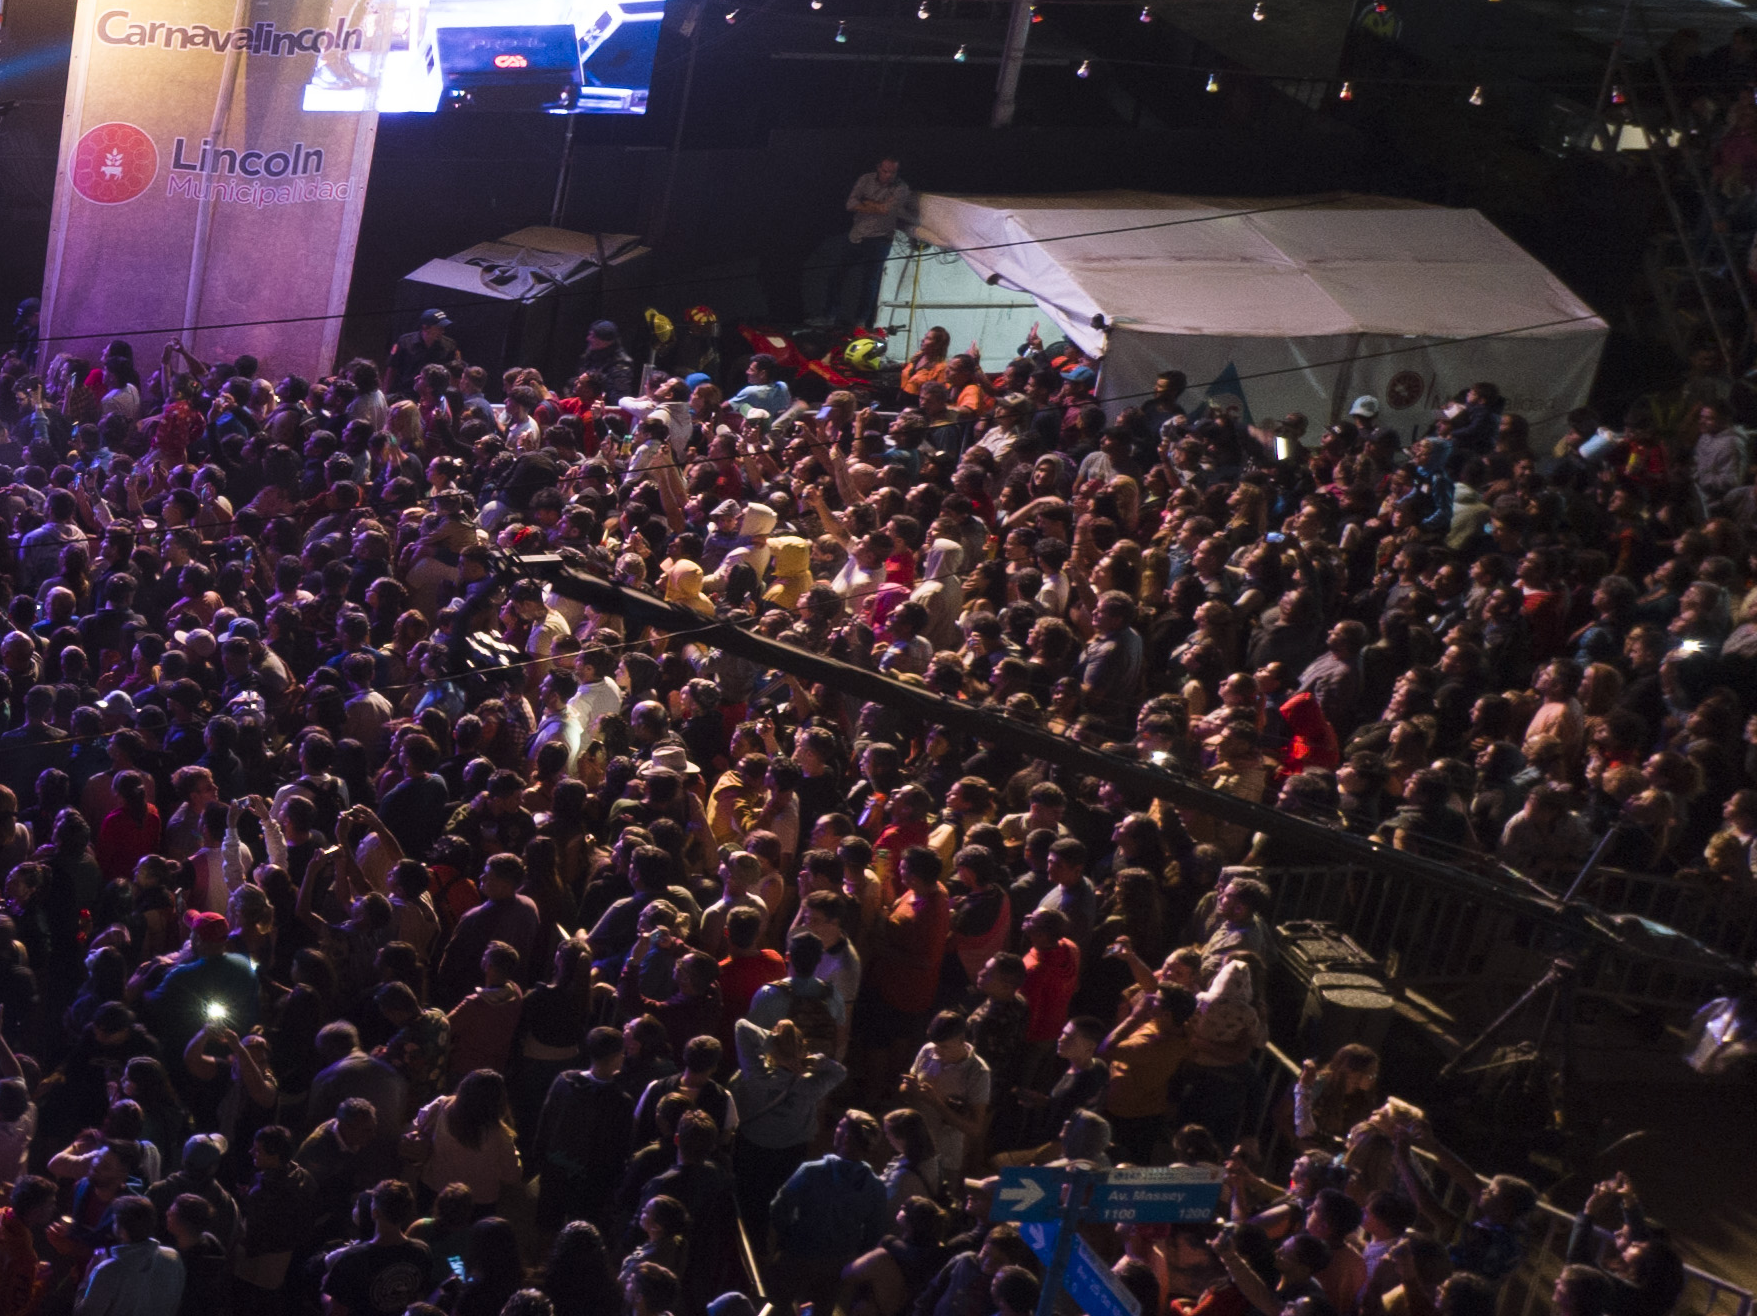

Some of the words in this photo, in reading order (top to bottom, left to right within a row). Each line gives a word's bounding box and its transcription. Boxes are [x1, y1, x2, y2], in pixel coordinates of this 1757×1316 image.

[95, 9, 363, 58] Carnavalincoln
[170, 136, 325, 179] Lincoln
[166, 173, 355, 210] Municipalidad
[1104, 1208, 1136, 1220] 1100
[1179, 1208, 1211, 1219] 1200
[1133, 1190, 1187, 1203] Massey
